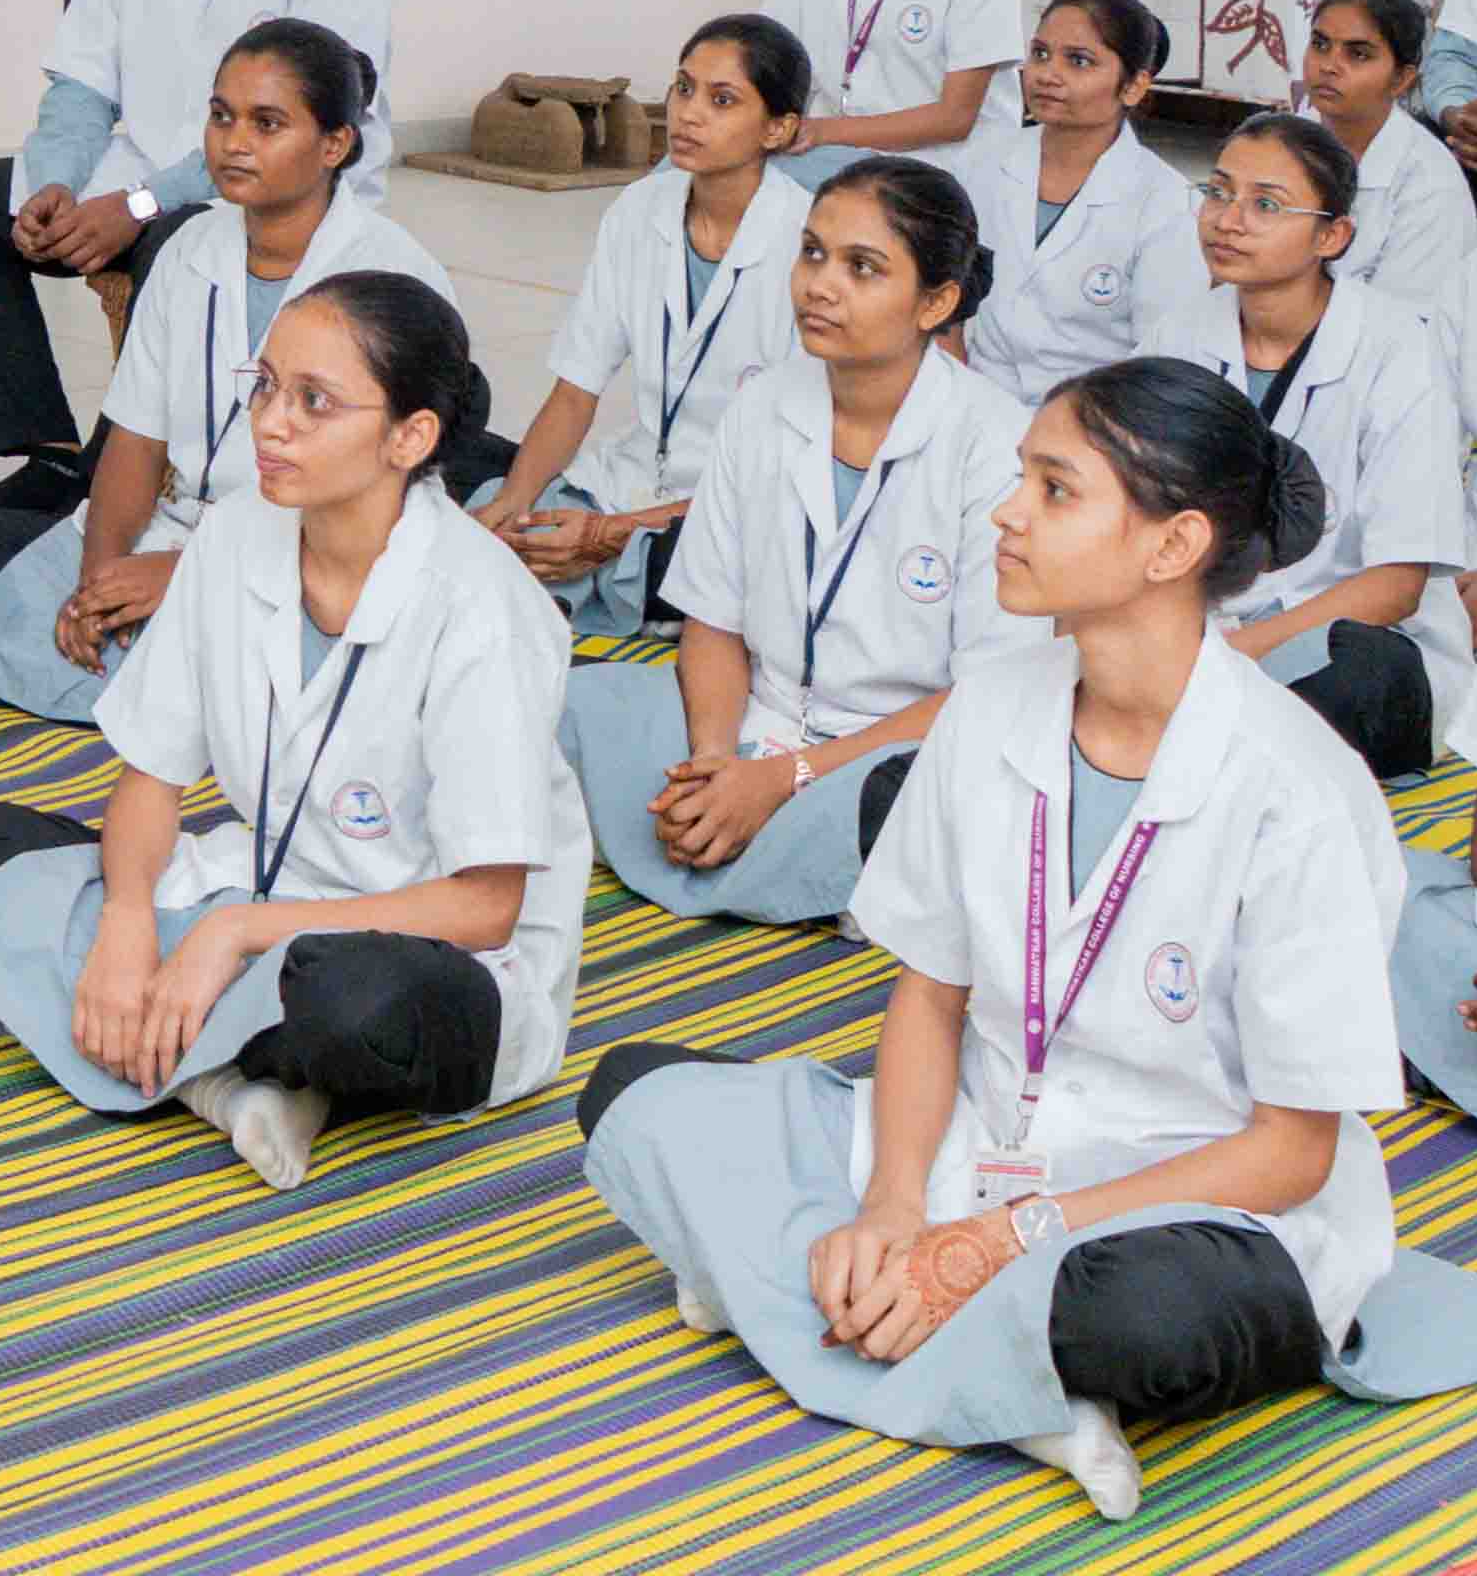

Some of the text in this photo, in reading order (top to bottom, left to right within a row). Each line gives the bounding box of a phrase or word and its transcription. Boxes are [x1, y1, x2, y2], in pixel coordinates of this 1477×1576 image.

[1088, 833, 1146, 949] COLLEGE OF NURSING
